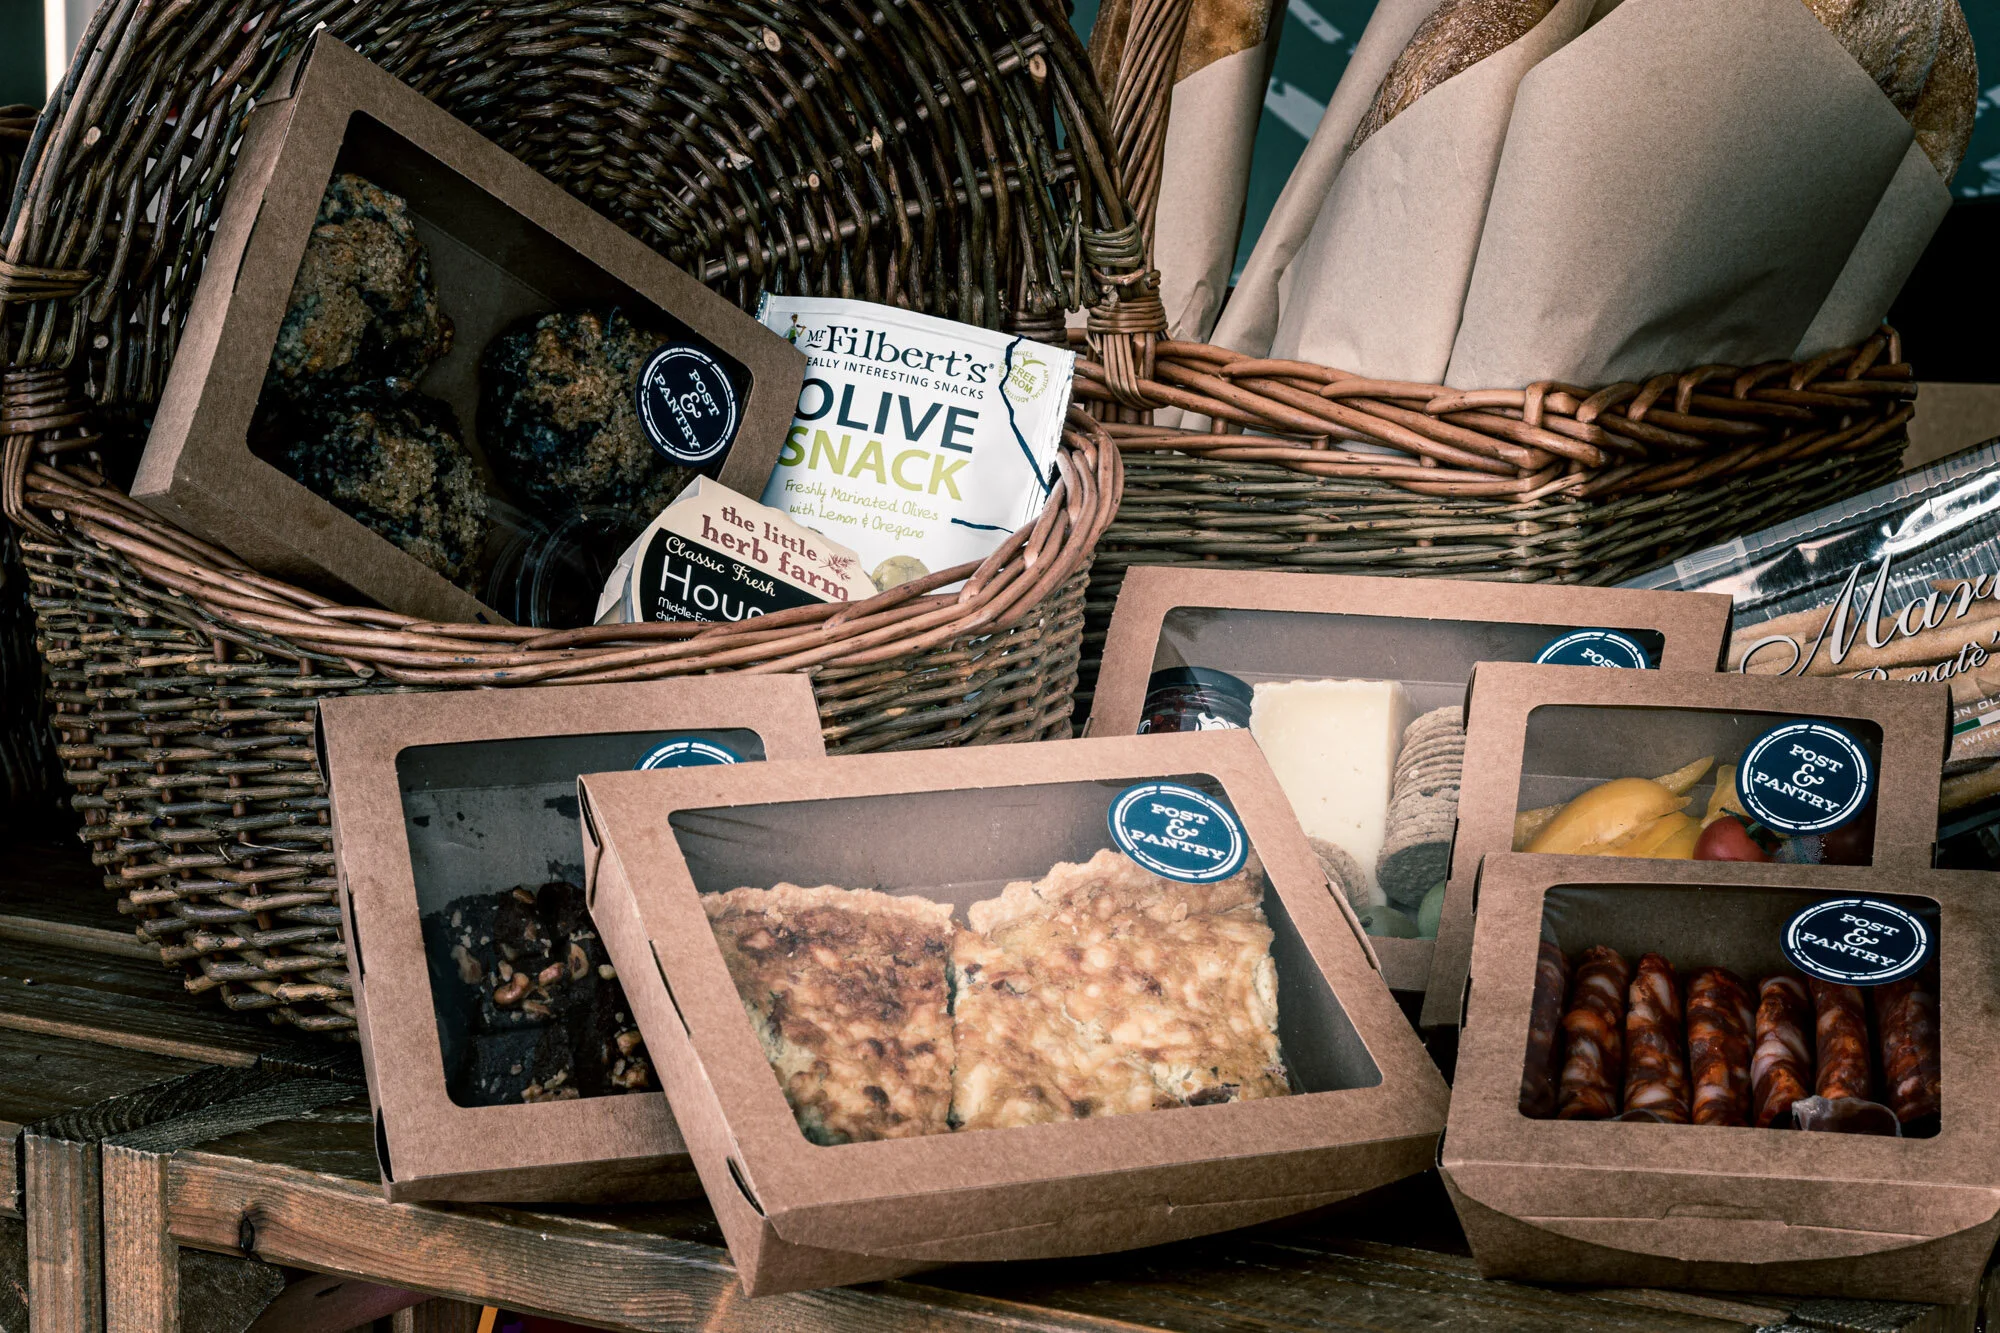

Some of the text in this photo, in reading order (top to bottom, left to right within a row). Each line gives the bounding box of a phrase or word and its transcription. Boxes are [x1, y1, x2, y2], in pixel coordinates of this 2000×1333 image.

[822, 325, 988, 384] Filbert's
[1011, 364, 1037, 384] FREE
[688, 368, 720, 416] POST
[806, 357, 984, 400] EALLY INTERESTING SNACKS
[653, 373, 701, 449] PANTRY
[680, 392, 702, 418] &
[796, 377, 979, 454] OLIVE
[775, 426, 970, 501] SNACK
[785, 478, 938, 521] Freshly Marinated Olives
[721, 505, 817, 561] the little
[789, 502, 924, 540] with Lemon & Oregano
[665, 536, 776, 597] Classic Fresh
[701, 514, 850, 601] herb farm
[1789, 744, 1843, 773] POST
[1792, 763, 1825, 787] &
[1754, 772, 1840, 812] PANTRY
[1151, 803, 1209, 825] POST
[1166, 818, 1199, 839] &
[1130, 829, 1226, 860] PANTRY
[1840, 913, 1899, 936] POST
[1843, 928, 1879, 946] &
[1800, 932, 1897, 967] PANTRY
